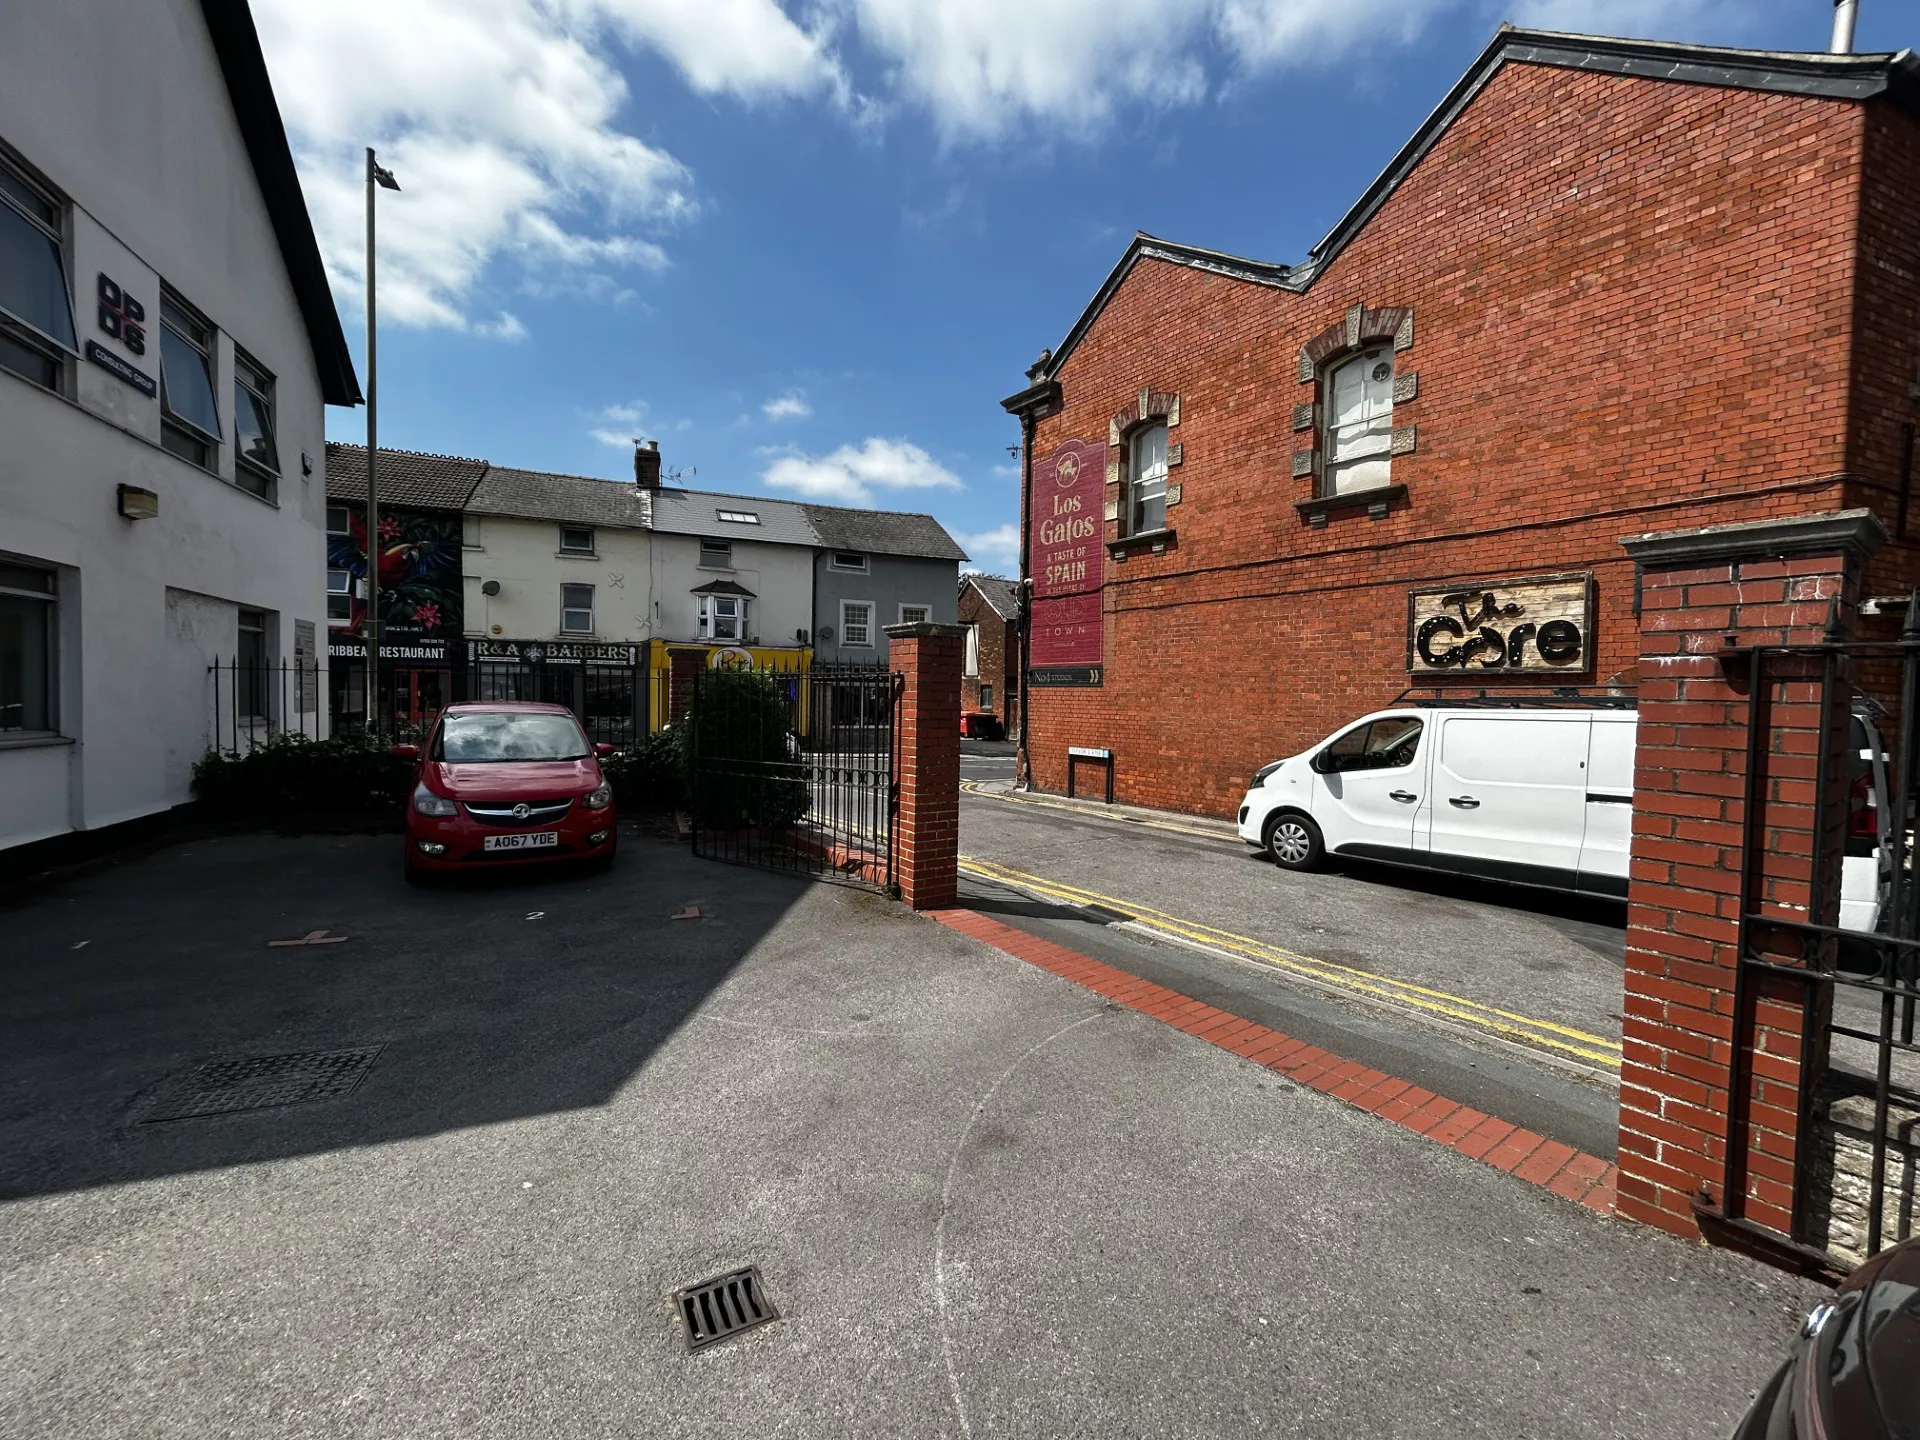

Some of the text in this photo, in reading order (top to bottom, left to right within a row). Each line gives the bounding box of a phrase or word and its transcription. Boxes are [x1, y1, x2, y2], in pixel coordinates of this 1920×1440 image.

[95, 349, 153, 389] CONSULTING GROUP
[1053, 495, 1082, 517] Los
[1040, 516, 1095, 545] Gatos
[1047, 547, 1086, 562] A TASTE OF
[1046, 561, 1086, 585] SPAIN
[1045, 597, 1087, 626] OLD
[1441, 590, 1525, 631] The
[1045, 626, 1086, 637] TOWN
[1417, 616, 1580, 667] Core
[328, 645, 445, 659] RIBBEA RESTAURANT
[476, 641, 629, 659] R&A BARBERS
[494, 833, 555, 848] AO67 YDE
[525, 911, 545, 921] 2
